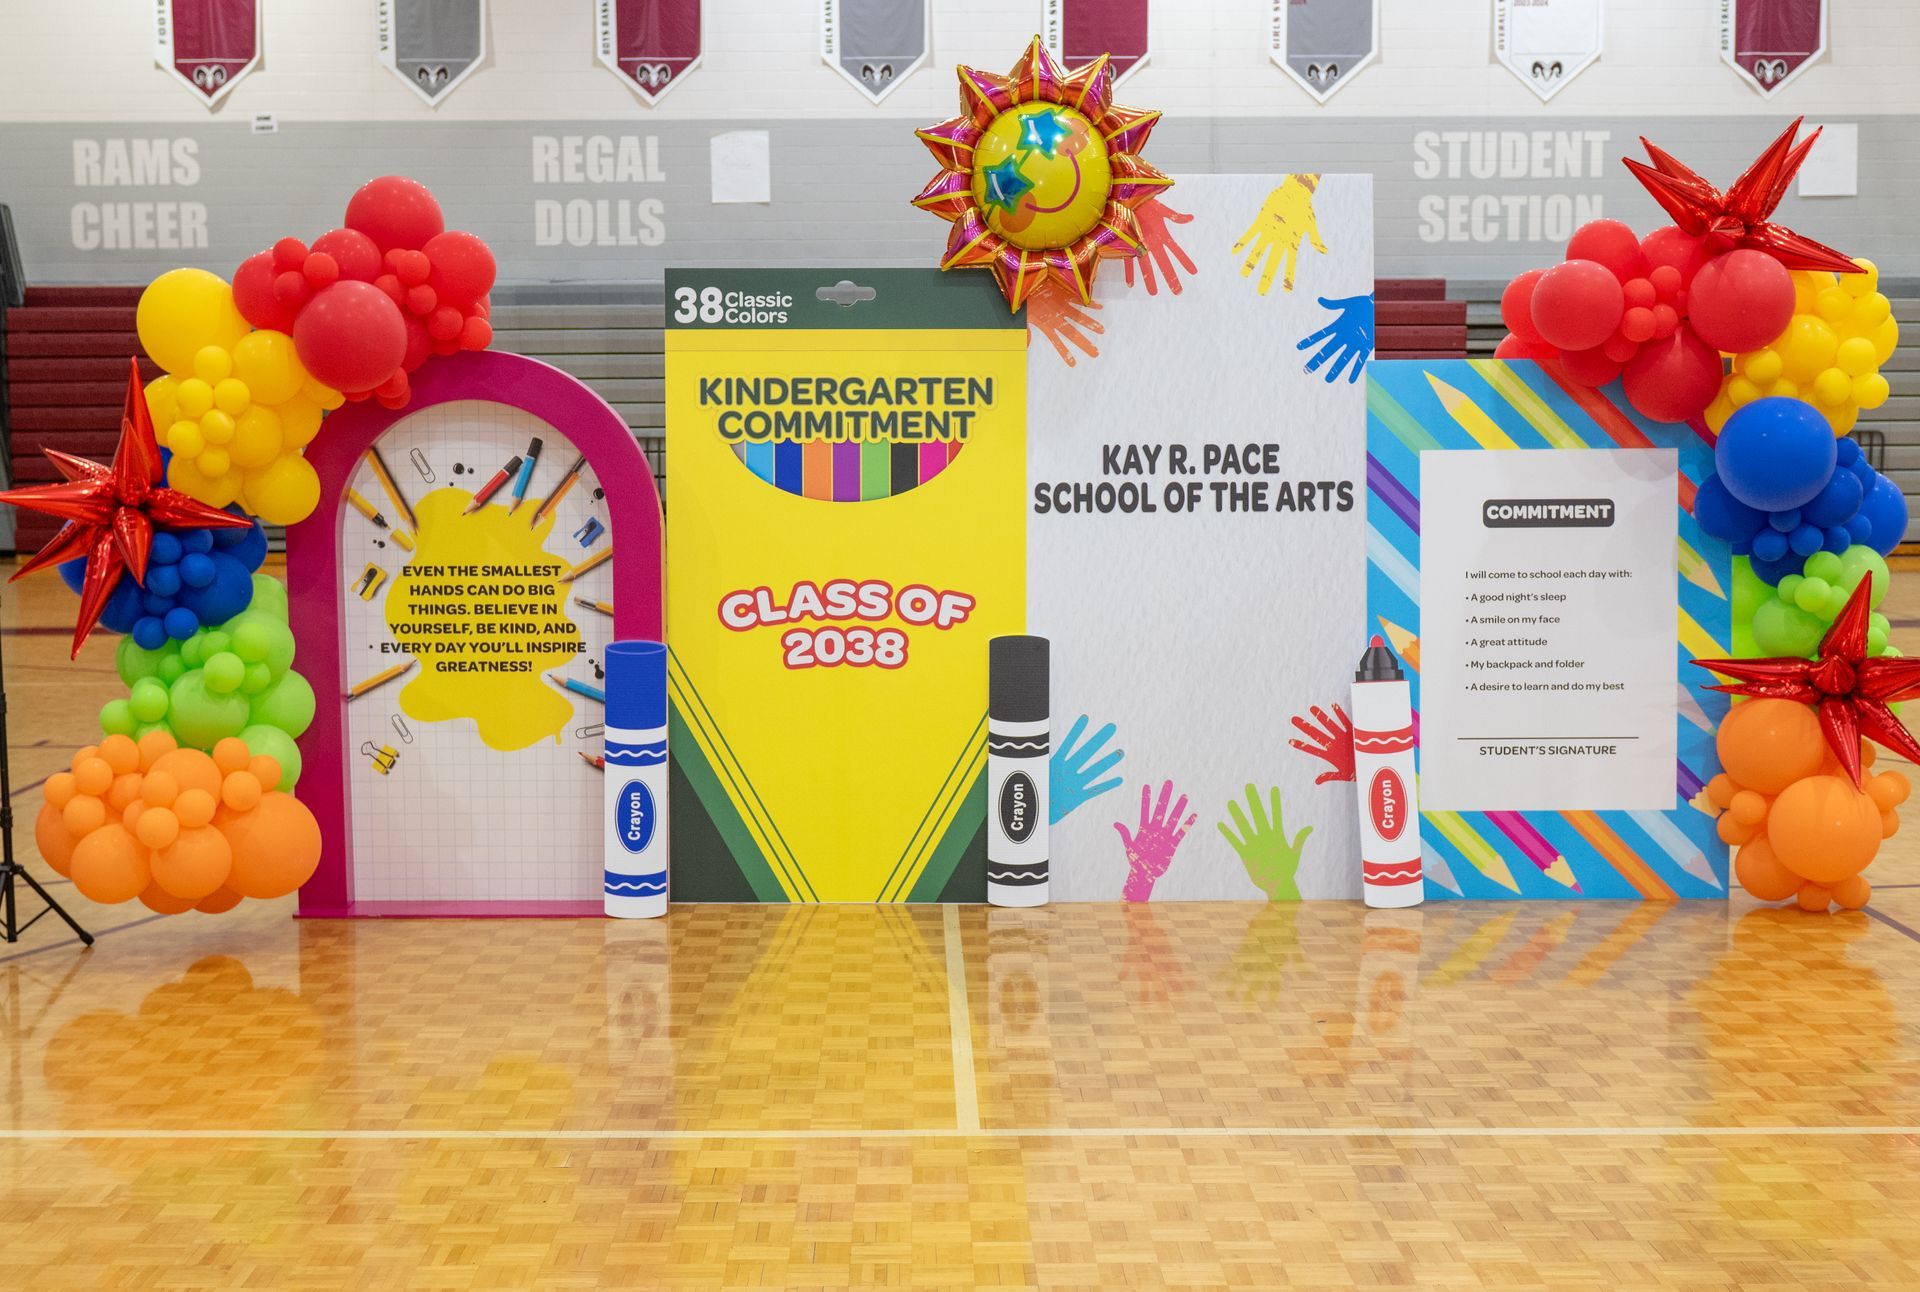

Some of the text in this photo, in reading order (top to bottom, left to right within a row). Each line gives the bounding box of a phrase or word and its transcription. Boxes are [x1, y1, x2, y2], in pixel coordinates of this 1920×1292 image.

[72, 137, 201, 186] RAMS
[532, 135, 666, 183] REGAL
[1413, 131, 1610, 179] STUDENT
[71, 201, 209, 250] CHEER
[535, 199, 666, 247] DOLLS
[1418, 194, 1603, 243] SECTION
[674, 286, 724, 324] 38
[724, 291, 793, 308] Classic
[724, 308, 788, 324] Colors
[699, 377, 993, 406] KINDERGARTEN
[717, 410, 976, 439] COMMITMENT
[1102, 443, 1280, 475] KAY R. PACE
[1034, 481, 1354, 514] SCHOOL OF THE ARTS
[1486, 504, 1612, 520] COMMITMENT
[402, 565, 561, 577] EVEN THE SMALLEST
[1465, 570, 1633, 580] I will come to school each day with:
[410, 584, 556, 596] HANDS CAN DO BIG
[1471, 592, 1567, 603] A good night's sleep
[408, 603, 558, 615] THINGS. BELIEVE IN
[719, 580, 974, 630] CLASS OF
[390, 623, 577, 635] YOURSELF, BE KIND, AND
[1471, 616, 1478, 624] A
[1480, 615, 1506, 624] smile
[1521, 617, 1537, 625] my
[1538, 615, 1560, 624] face
[380, 642, 587, 653] EVERY DAY YOU'LL INSPIRE
[783, 628, 907, 667] 2038
[1470, 638, 1548, 648] A great attitude
[436, 661, 533, 673] GREATNESS!
[1470, 659, 1585, 670] My backpack and folder
[1470, 682, 1625, 692] A desire to learn and do my best
[1479, 745, 1617, 756] STUDENT'S SIGNATURE
[1010, 783, 1027, 831] Crayon
[1382, 779, 1396, 829] Crayon
[627, 792, 644, 841] Crayon
